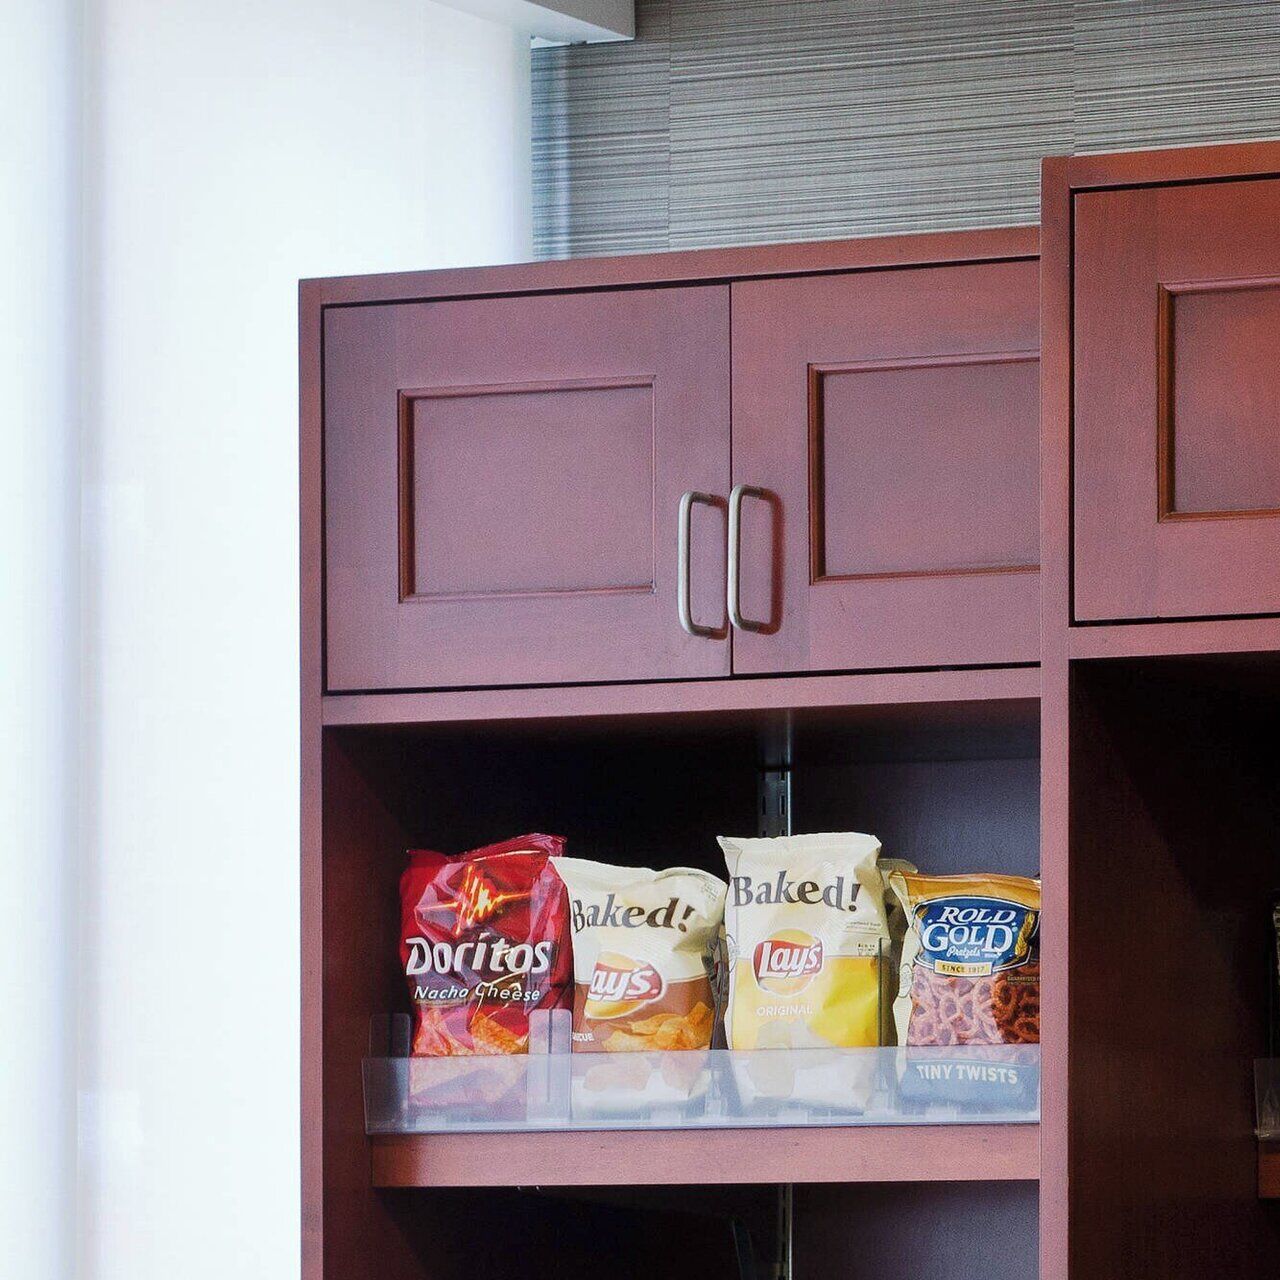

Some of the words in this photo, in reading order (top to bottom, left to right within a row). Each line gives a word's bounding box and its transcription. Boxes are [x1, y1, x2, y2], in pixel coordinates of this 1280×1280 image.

[732, 870, 862, 912] Baked!
[940, 906, 1014, 924] ROLD
[405, 932, 552, 976] Doritos
[922, 923, 1013, 955] GOLD
[757, 940, 823, 978] Lay's
[414, 985, 468, 1000] Nacho
[476, 983, 540, 1001] Cheese
[588, 968, 659, 1001] ay's
[756, 1005, 814, 1017] ORIGINAL
[916, 1064, 951, 1081] TINY
[957, 1064, 1018, 1084] TWISTS
